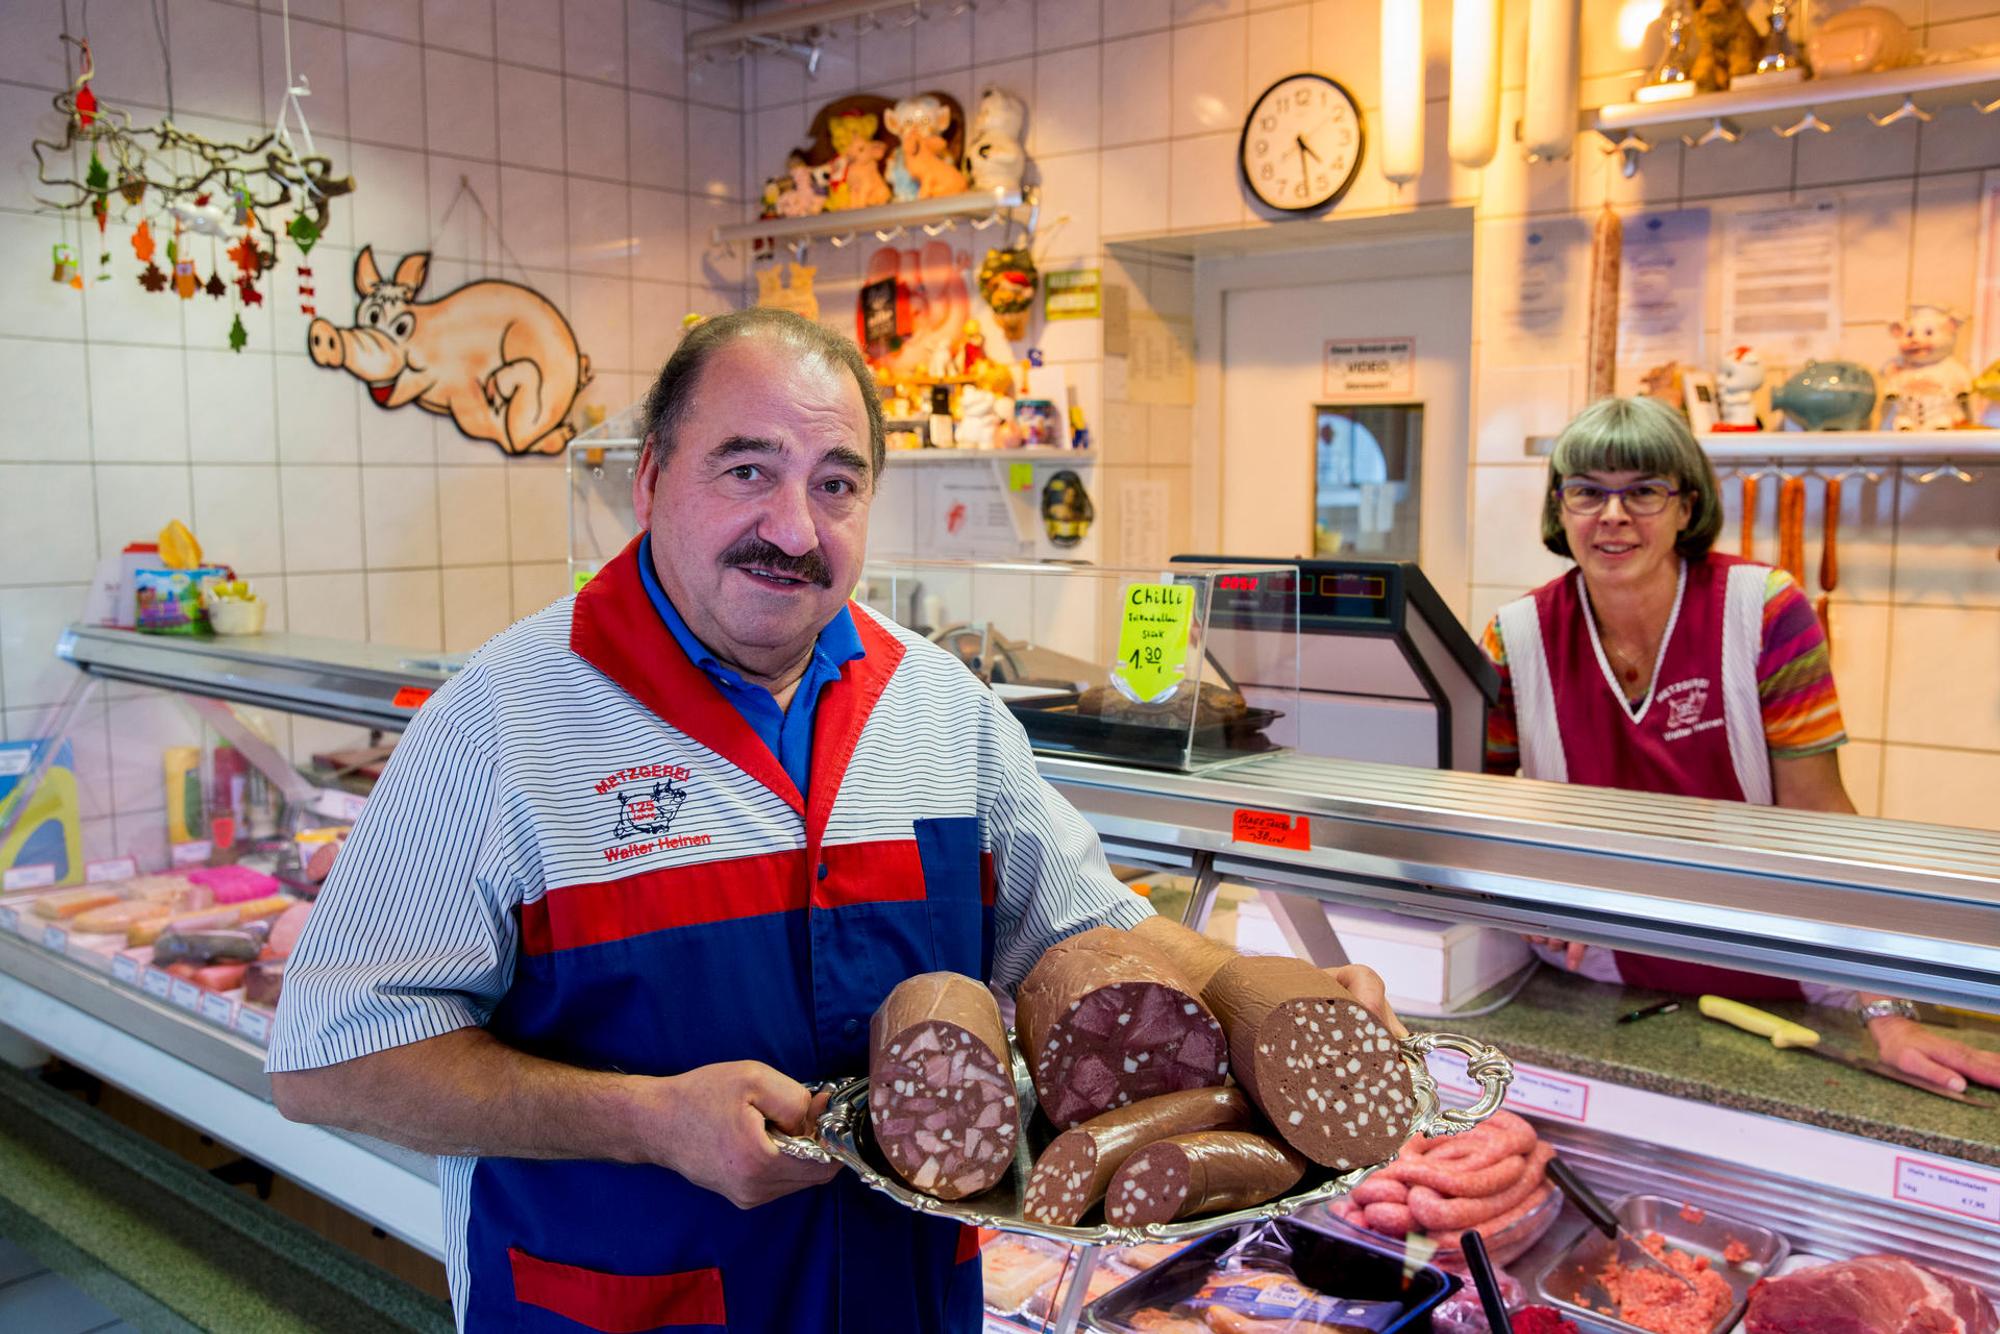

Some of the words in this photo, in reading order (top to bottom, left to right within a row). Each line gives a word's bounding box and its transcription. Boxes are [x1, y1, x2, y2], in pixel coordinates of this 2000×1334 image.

[1131, 588, 1182, 605] Chilli
[594, 765, 691, 796] METZGEREI
[628, 800, 655, 814] 125
[604, 842, 654, 862] Walter
[658, 833, 711, 850] Heinen
